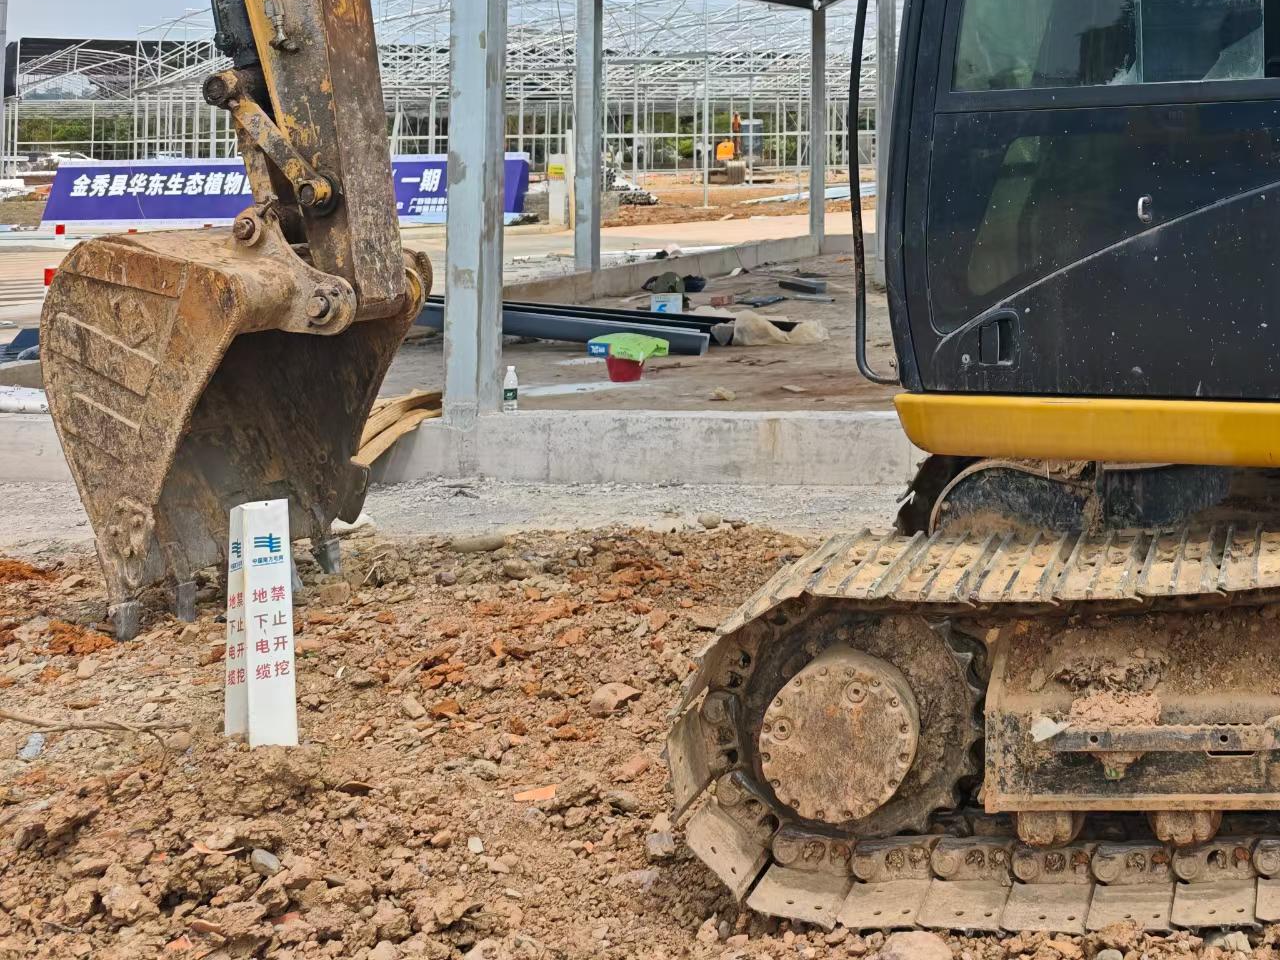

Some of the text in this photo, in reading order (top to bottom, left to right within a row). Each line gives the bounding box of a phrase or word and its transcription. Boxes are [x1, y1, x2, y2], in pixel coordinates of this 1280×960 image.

[252, 587, 272, 680] 地下电缆
[270, 585, 290, 677] 禁止开挖
